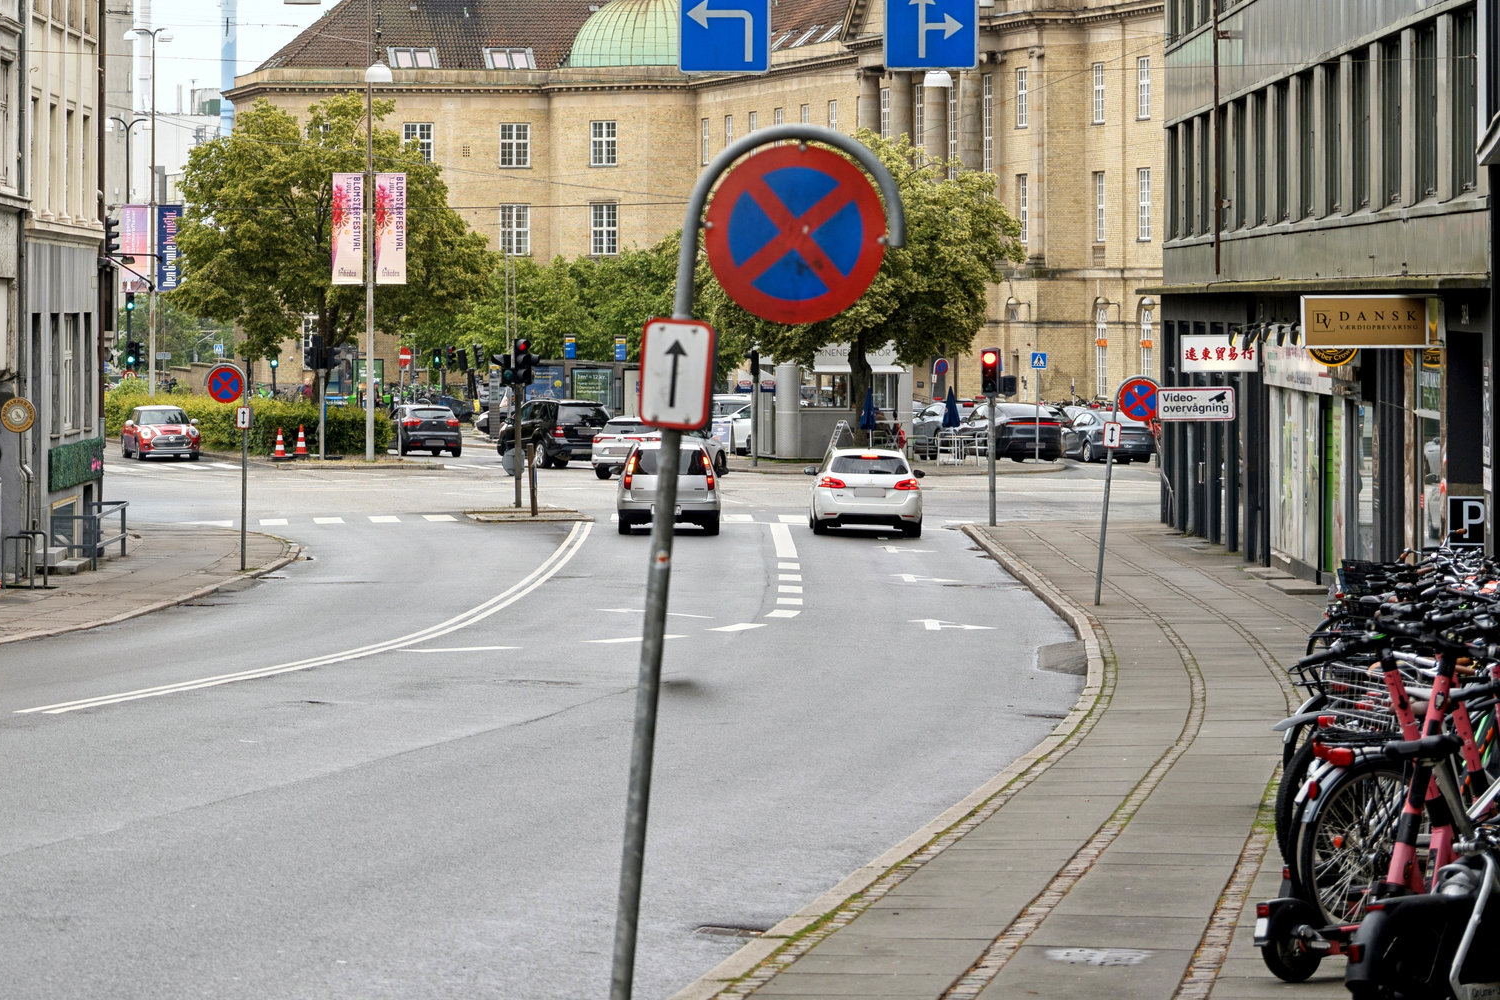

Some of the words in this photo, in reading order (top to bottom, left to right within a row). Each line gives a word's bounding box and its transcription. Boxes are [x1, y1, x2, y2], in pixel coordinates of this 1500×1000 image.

[353, 176, 361, 252] BLOMSTERFESTIVAL
[396, 176, 404, 252] BLOMSTERFESTIVAL
[162, 272, 177, 287] Den
[1339, 310, 1418, 321] DANSK
[1185, 346, 1255, 361] 遠東貿易行
[1163, 393, 1198, 402] Video-
[1163, 403, 1229, 414] overvågning
